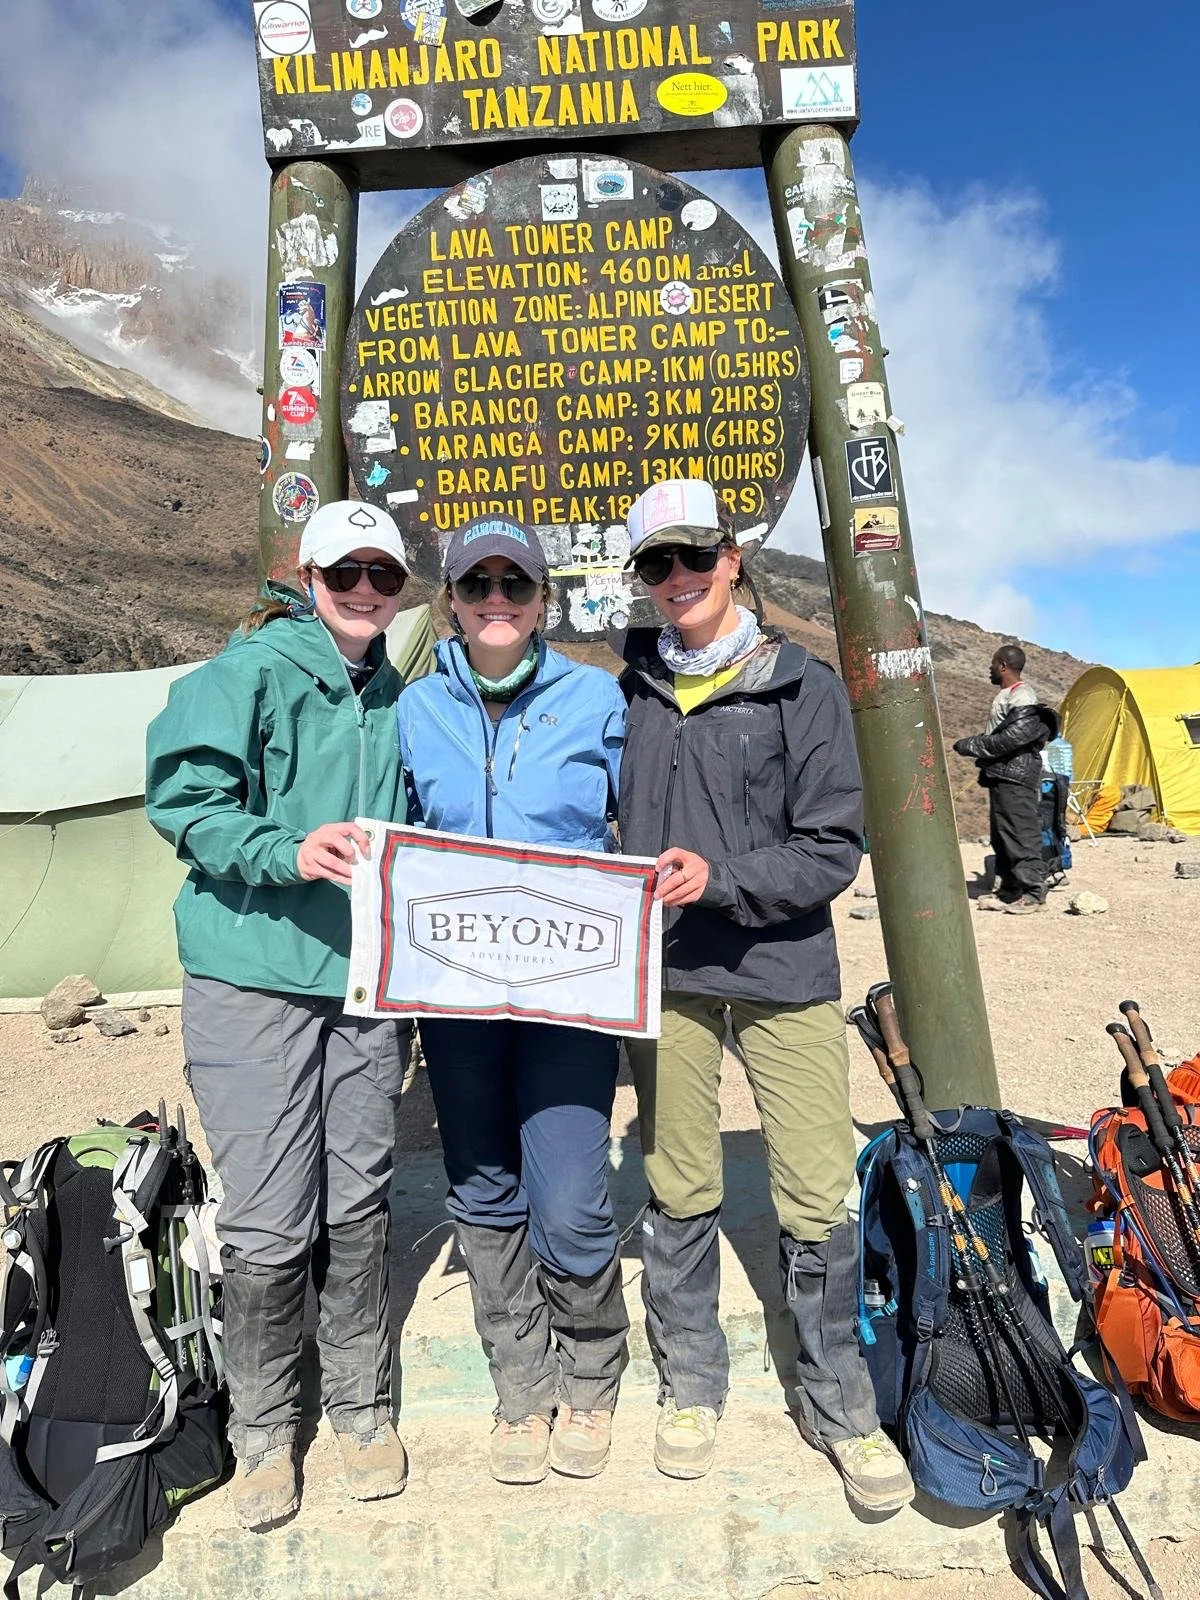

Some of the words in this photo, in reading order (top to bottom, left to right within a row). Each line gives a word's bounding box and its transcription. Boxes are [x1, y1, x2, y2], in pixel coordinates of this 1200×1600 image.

[273, 38, 503, 95] KILIMANJARO
[537, 24, 712, 76] NATIONAL
[757, 18, 845, 63] PARK
[463, 79, 640, 131] TANZANIA
[672, 82, 692, 91] Nett
[430, 228, 495, 262] LAVA
[505, 223, 595, 256] TOWER
[605, 216, 673, 251] CAMP
[422, 261, 588, 294] ELEVATION:
[600, 253, 691, 285] 4600M
[696, 249, 757, 281] amsl
[365, 297, 498, 333] VEGETATION
[512, 293, 583, 325] ZONE:
[689, 282, 775, 315] DESERT
[358, 334, 440, 367] FROM
[452, 330, 522, 360] LAVA
[541, 324, 637, 355] TOWER
[650, 320, 726, 350] CAMP
[362, 368, 440, 398] ARROW
[453, 362, 565, 394] GLACIER
[580, 358, 657, 386] CAMP:
[661, 355, 705, 384] 1KM
[709, 345, 801, 384] (0.5HRS)
[281, 404, 315, 413] SUMMITS
[287, 390, 298, 405] 7
[556, 391, 638, 422] CAMP:
[710, 379, 782, 415] 2HRS)
[418, 430, 543, 461] KARANGA
[558, 426, 633, 455] CAMP:
[643, 422, 700, 450] 9KM
[704, 415, 785, 453] (6HRS)
[437, 464, 547, 496] BARAFU
[559, 460, 633, 490] CAMP:
[640, 456, 704, 485] 13KM
[706, 447, 785, 487] (10HRS)
[532, 495, 606, 525] PEAK:
[463, 520, 530, 549] CAROLINA
[539, 713, 558, 726] OR
[428, 913, 605, 953] BEYOND
[469, 951, 555, 965] ADVENTURES
